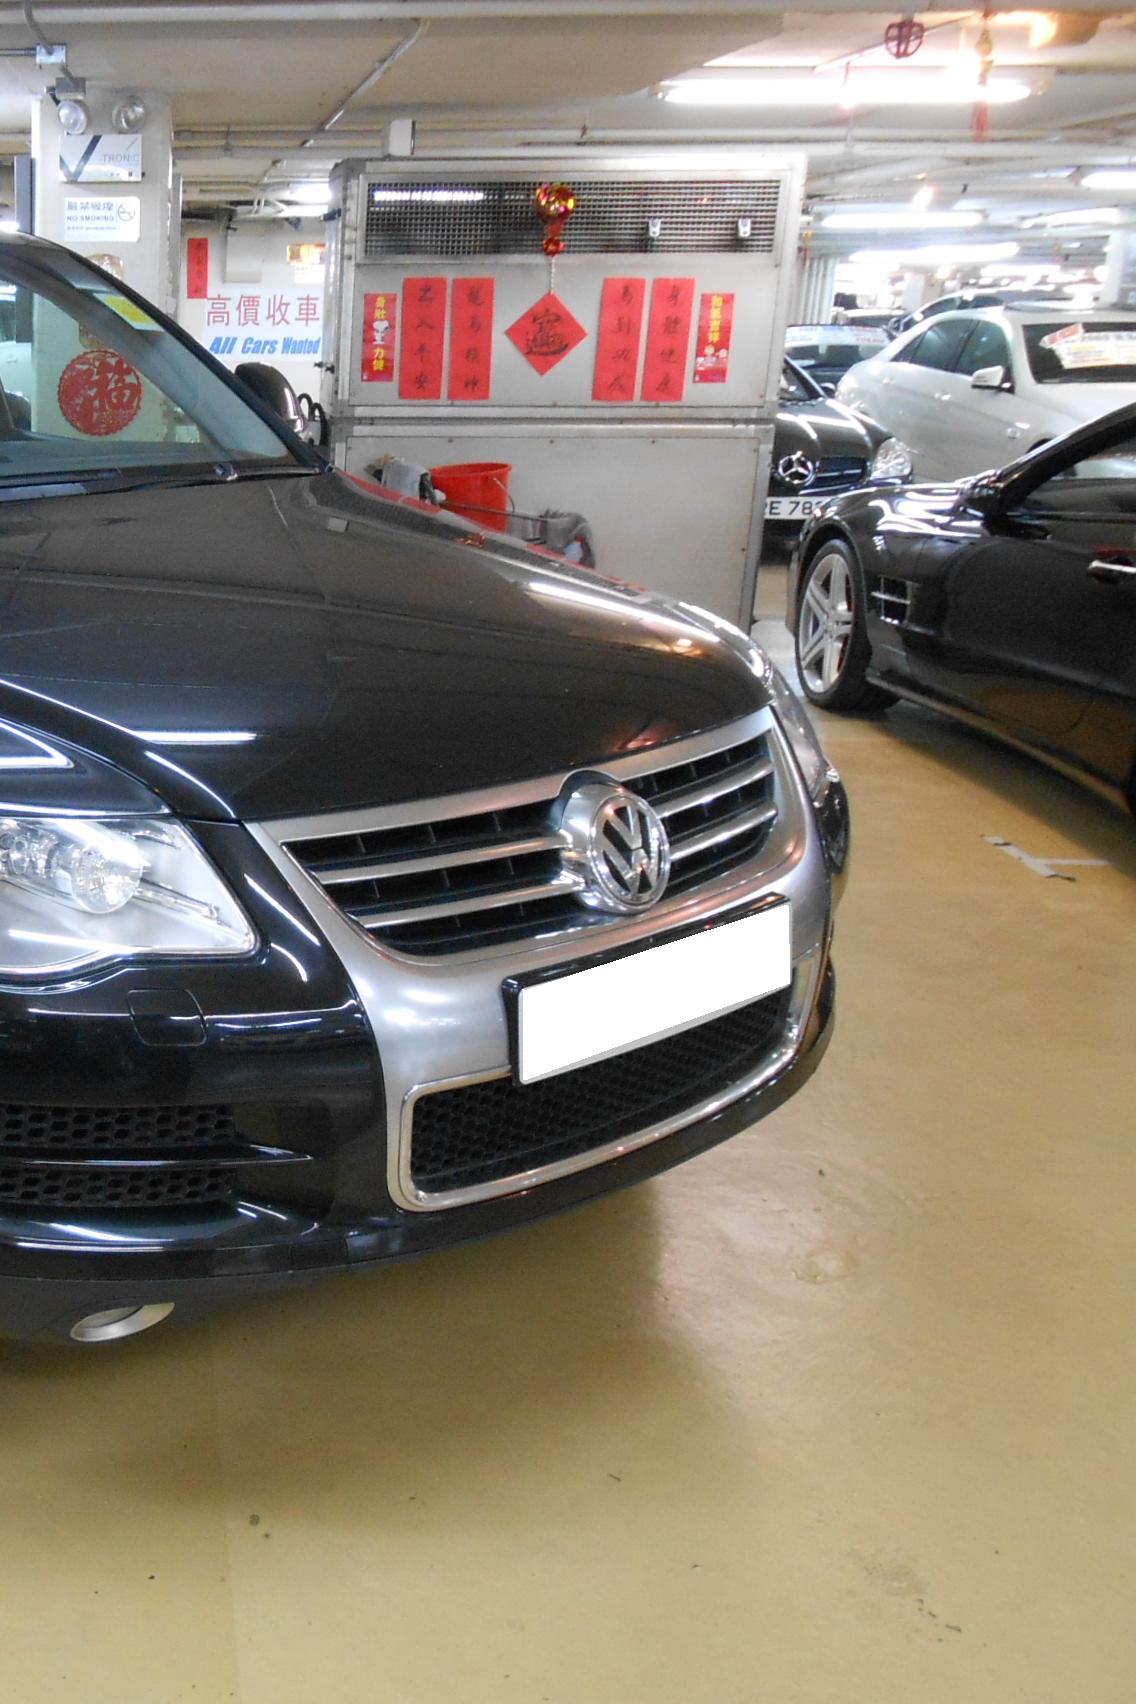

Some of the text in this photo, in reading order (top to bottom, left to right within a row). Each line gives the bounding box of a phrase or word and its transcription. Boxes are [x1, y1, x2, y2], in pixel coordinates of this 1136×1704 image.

[206, 294, 321, 327] 高價收車
[209, 336, 321, 355] All Cars Wanted
[765, 500, 782, 515] E
